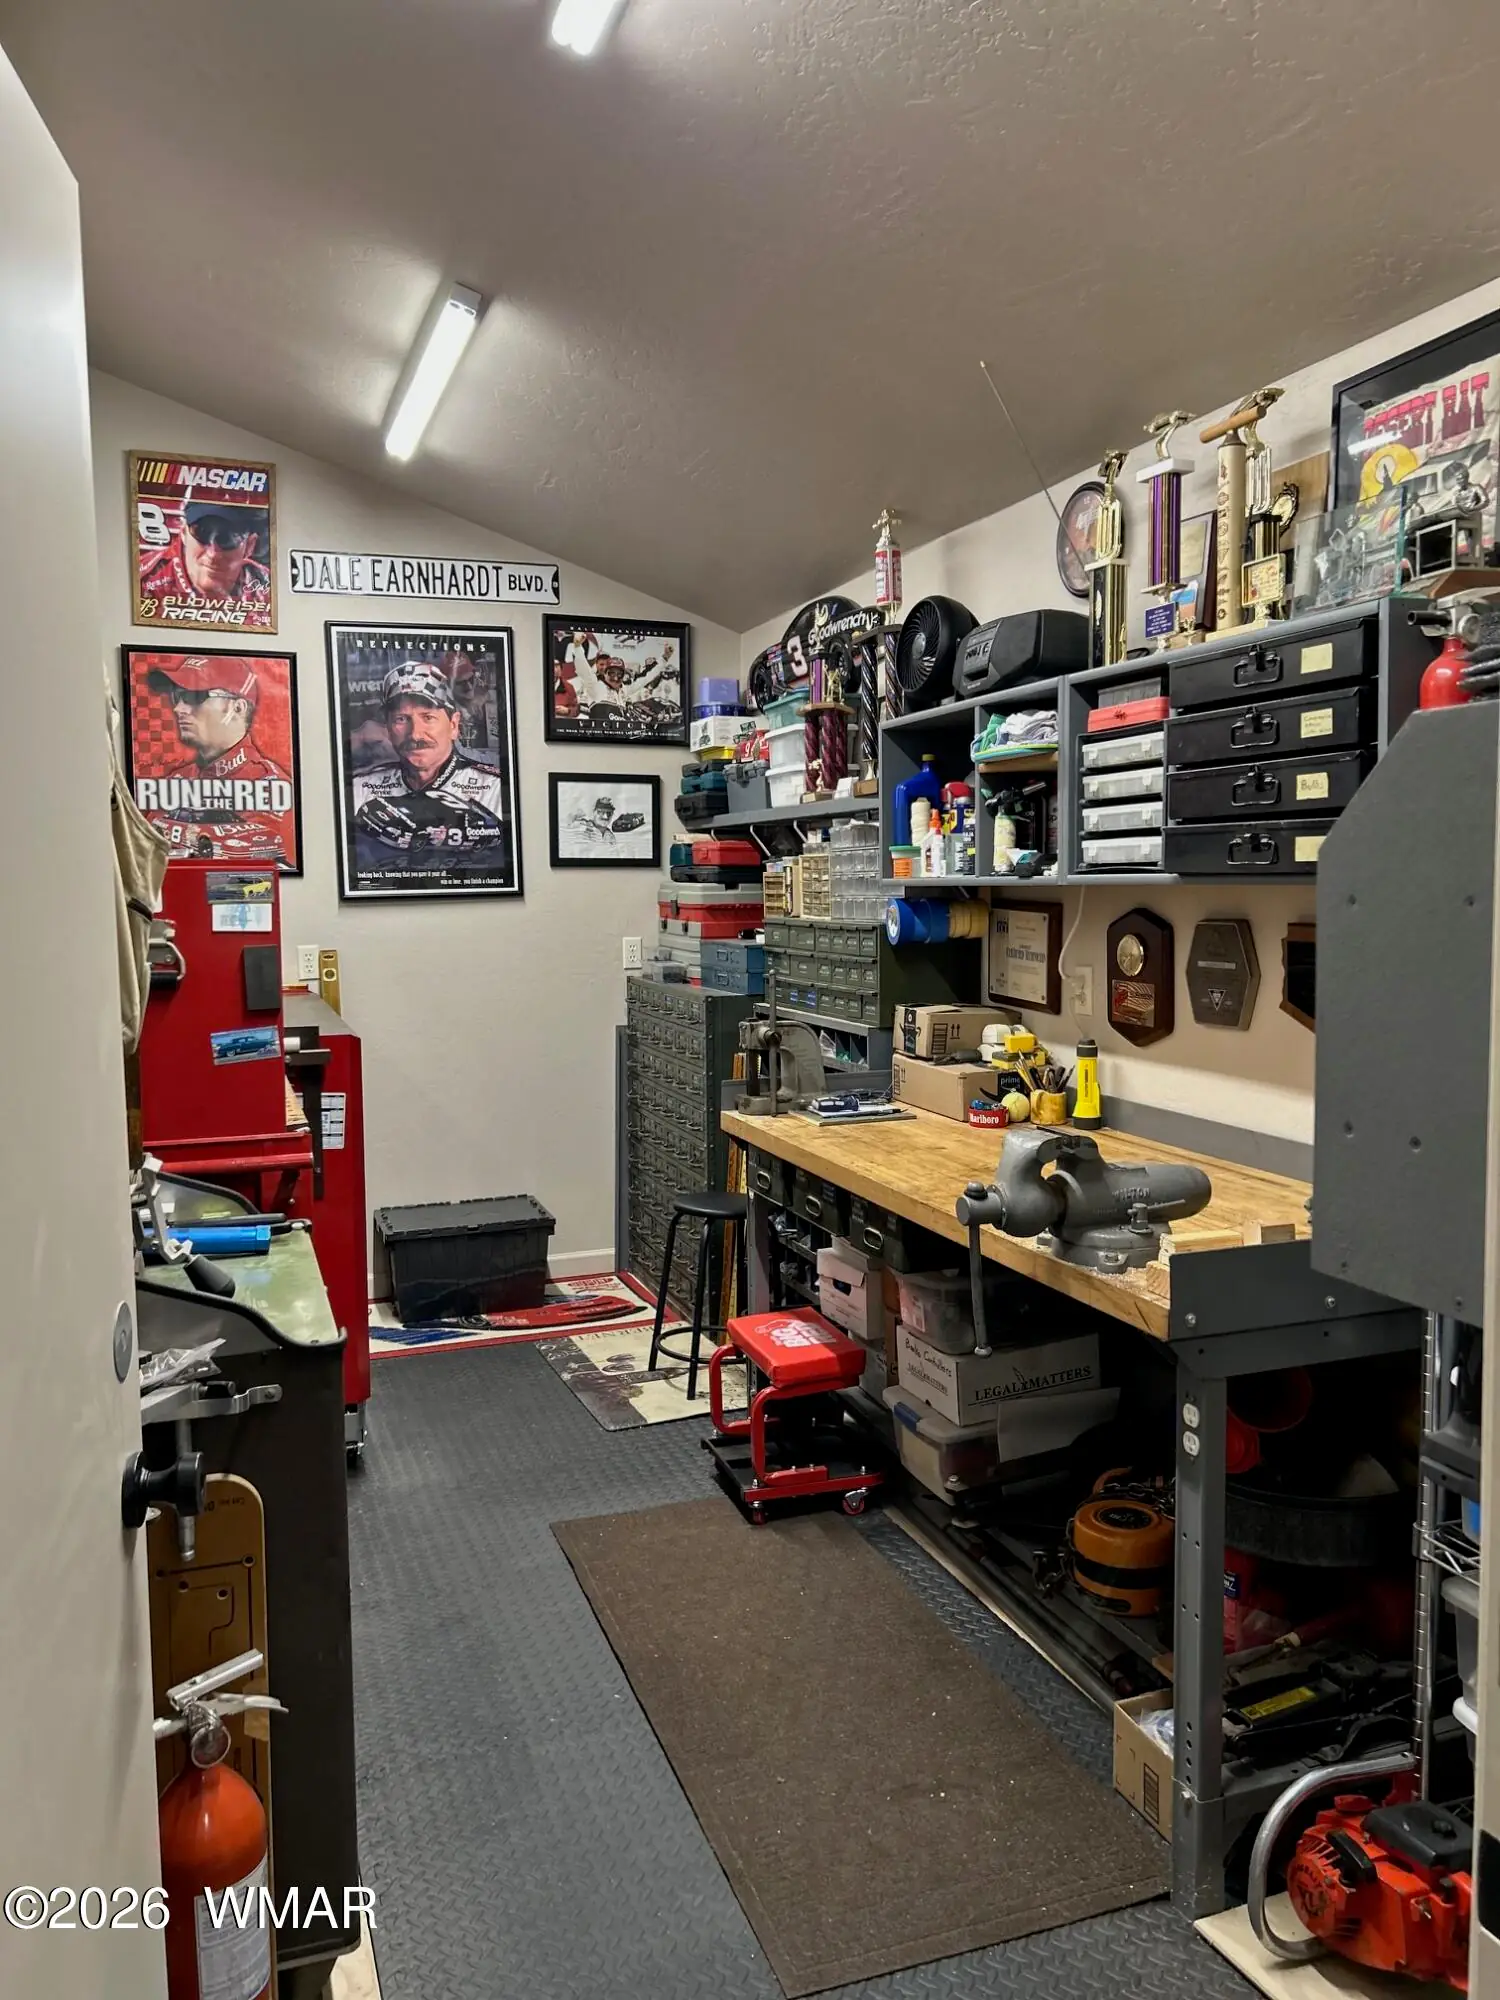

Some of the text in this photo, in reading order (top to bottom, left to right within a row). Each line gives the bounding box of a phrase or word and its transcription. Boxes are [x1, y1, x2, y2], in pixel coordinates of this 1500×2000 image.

[176, 465, 268, 492] NASCAR
[302, 555, 362, 591] DALE
[371, 559, 503, 598] EARNHARDT
[508, 574, 548, 593] BLVD.
[162, 607, 247, 625] RACING
[808, 610, 866, 645] Godwrench
[356, 640, 486, 652] REFLECTIONS
[787, 635, 808, 677] 3
[215, 748, 248, 777] Bud
[136, 778, 232, 811] RUN IN
[202, 798, 233, 810] THE
[234, 779, 292, 811] RED
[171, 825, 182, 843] 8
[447, 828, 463, 846] 3
[1001, 1076, 1020, 1085] prime
[969, 1113, 999, 1124] Marlboro
[975, 1382, 1020, 1401] LEGAL
[1027, 1366, 1091, 1390] MATTERS
